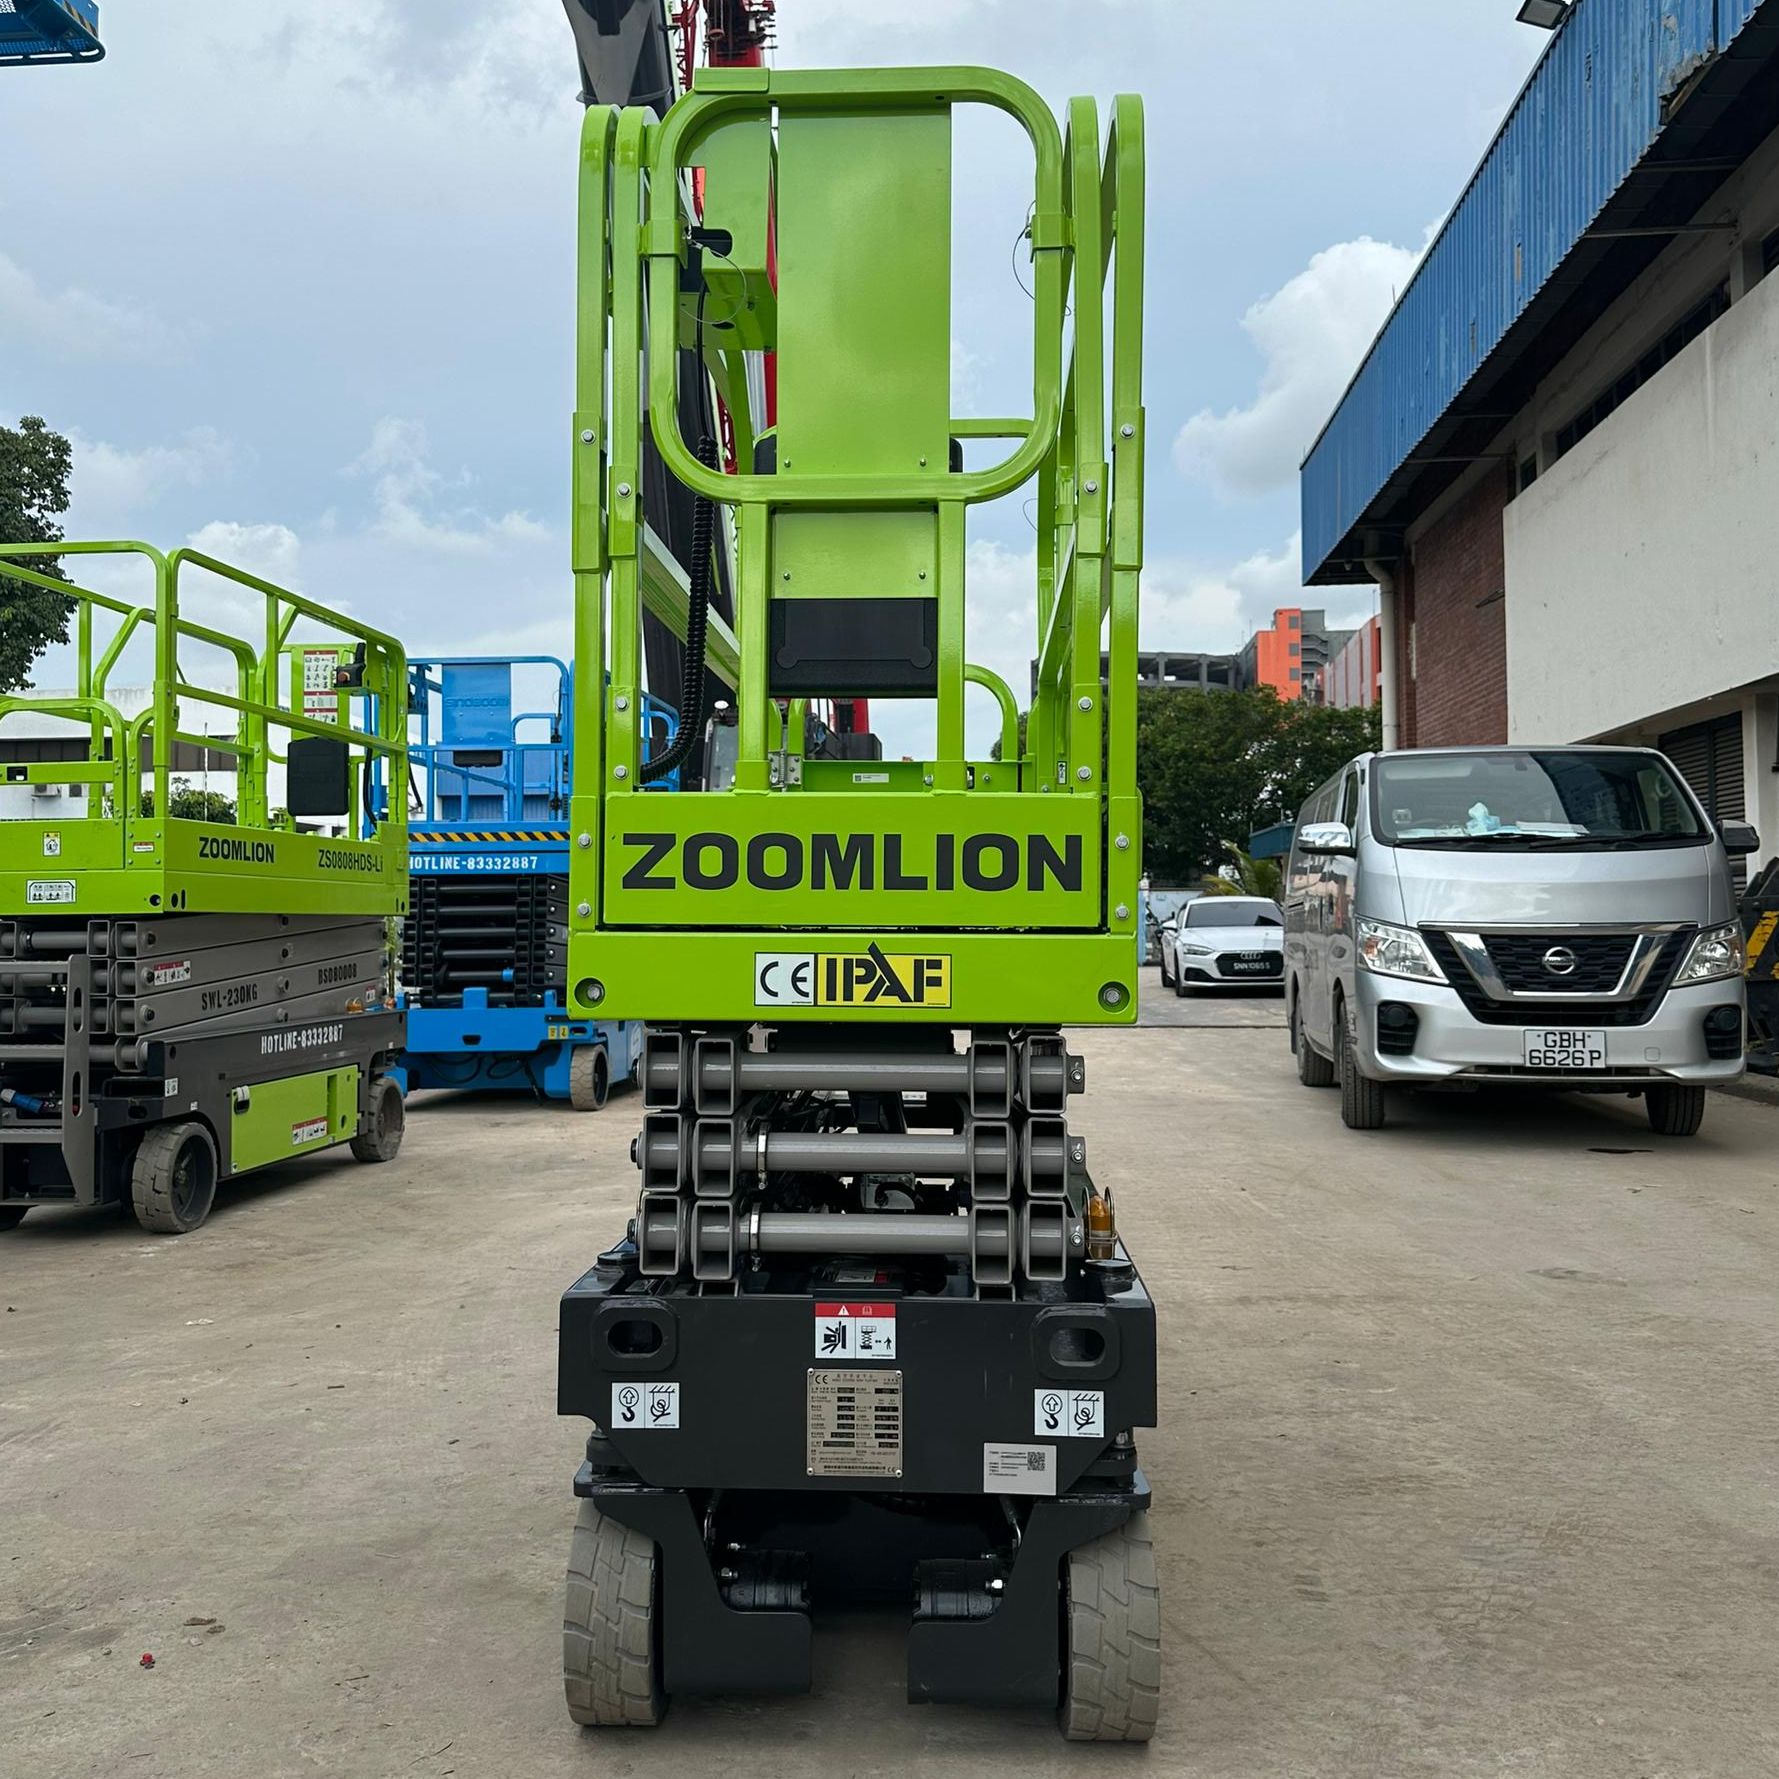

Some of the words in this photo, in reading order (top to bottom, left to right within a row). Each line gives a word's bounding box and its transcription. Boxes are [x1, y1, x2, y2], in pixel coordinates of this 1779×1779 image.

[199, 836, 275, 864] ZOOMLION
[318, 848, 384, 873] ZS0808HDS-Li
[622, 832, 1083, 891] ZOOMLION
[760, 961, 810, 998] CE
[825, 941, 943, 1003] IPAF
[201, 983, 258, 1011] SWL-230KG
[261, 1024, 344, 1055] HOTLINE-83332887
[1544, 1032, 1586, 1049] GBH
[815, 1374, 829, 1385] CE
